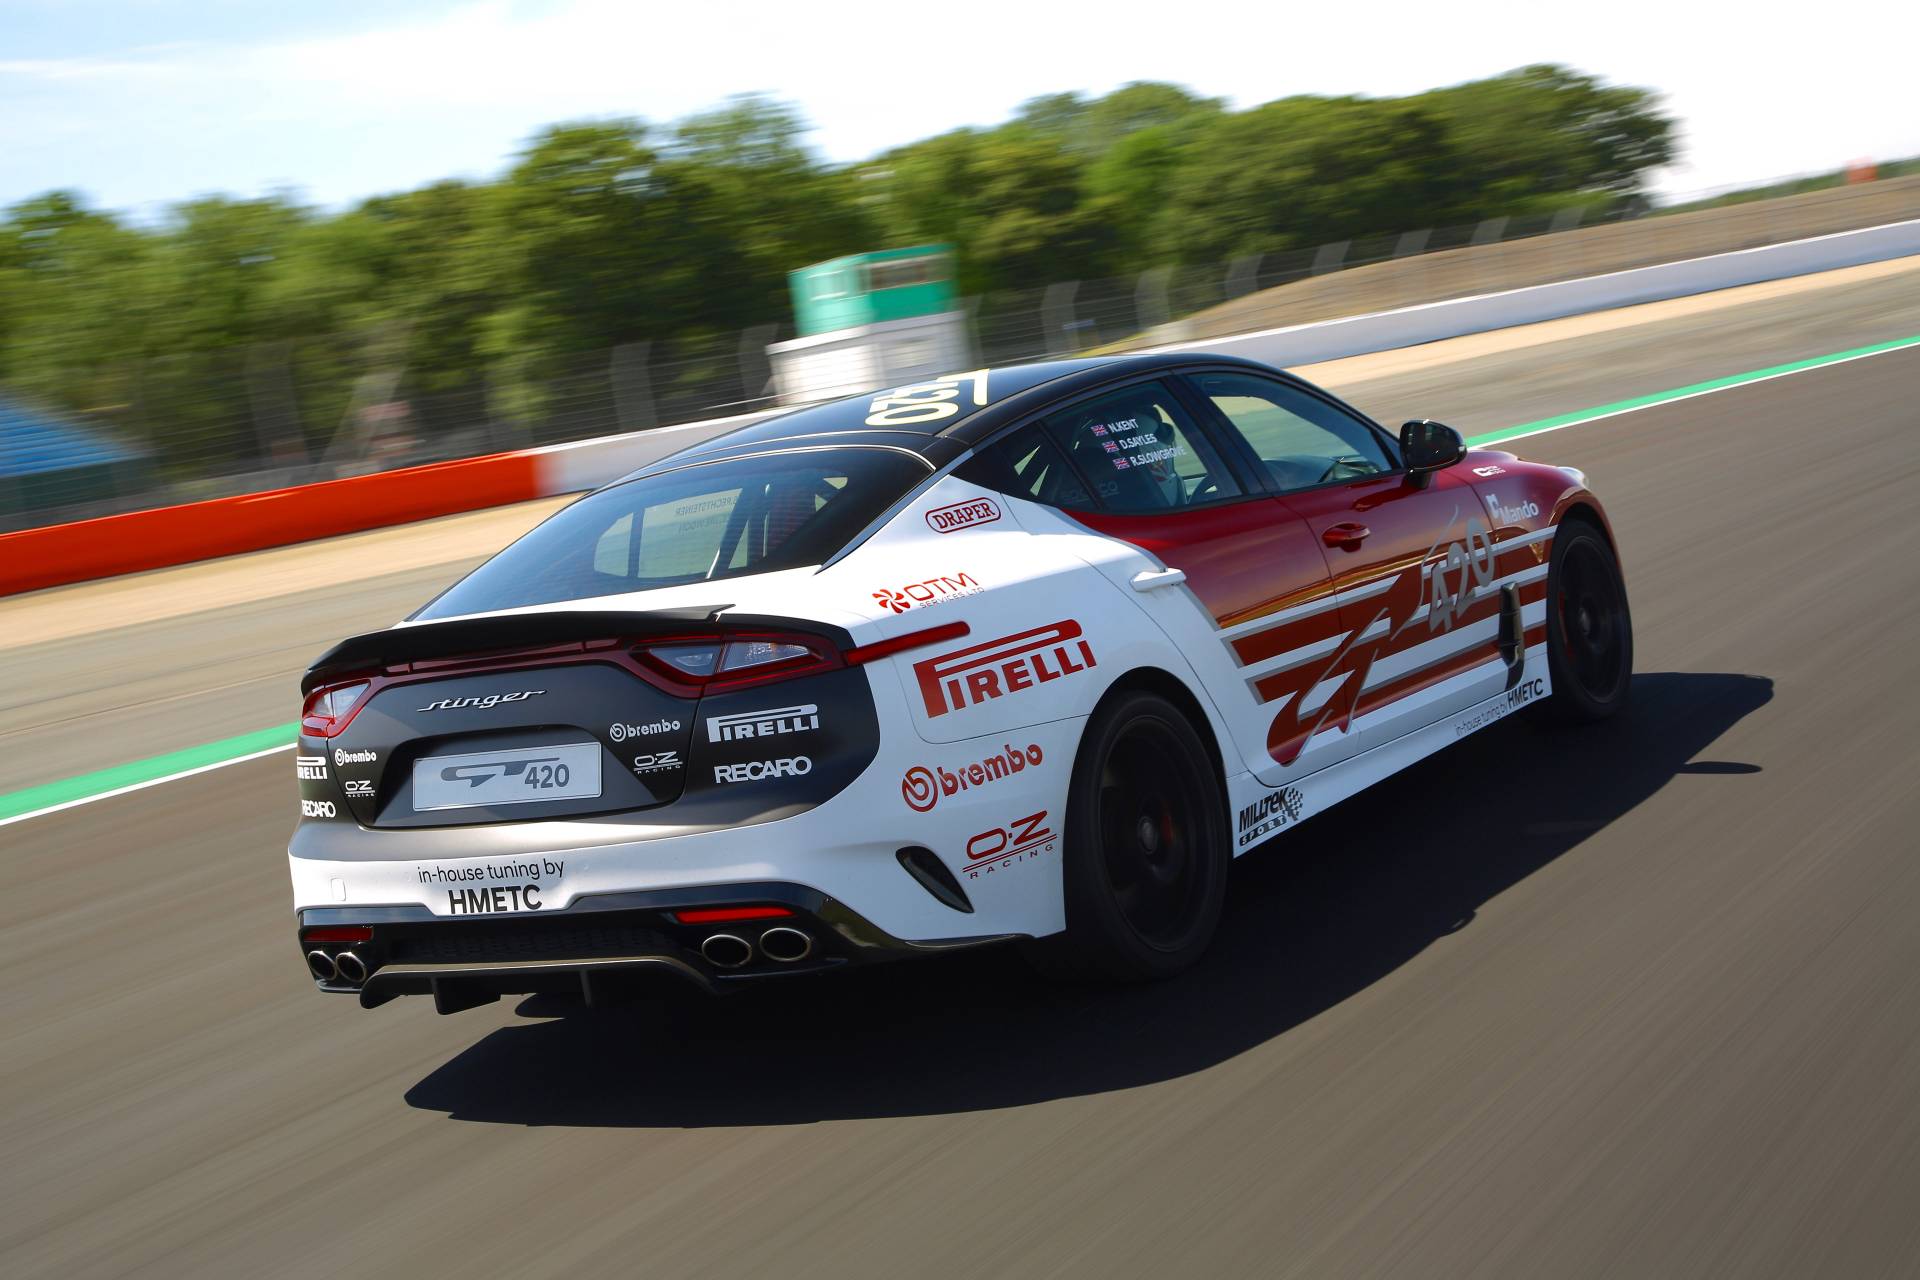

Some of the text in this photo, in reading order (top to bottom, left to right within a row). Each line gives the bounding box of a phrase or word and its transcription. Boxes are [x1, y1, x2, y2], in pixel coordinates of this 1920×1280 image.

[1108, 419, 1139, 433] N.KENT
[1119, 433, 1157, 449] D.SAYLES
[932, 502, 996, 530] DRAPER
[1499, 500, 1538, 525] Mando
[904, 573, 978, 601] OTM
[1429, 518, 1495, 633] 420
[920, 591, 966, 609] SERVICES
[913, 619, 1097, 718] PIRELLI
[416, 690, 546, 712] stinger
[1507, 678, 1544, 710] HMETC
[627, 719, 681, 737] brembo
[706, 703, 820, 743] PIRELLI
[344, 749, 377, 763] brembo
[637, 765, 681, 775] RACING
[714, 756, 812, 784] RECARO
[937, 743, 1043, 797] brembo
[524, 763, 570, 789] 420
[1241, 815, 1286, 845] SPORT
[418, 858, 564, 883] in-house tuning by
[970, 844, 1054, 879] RACING
[448, 884, 542, 914] HMETC
